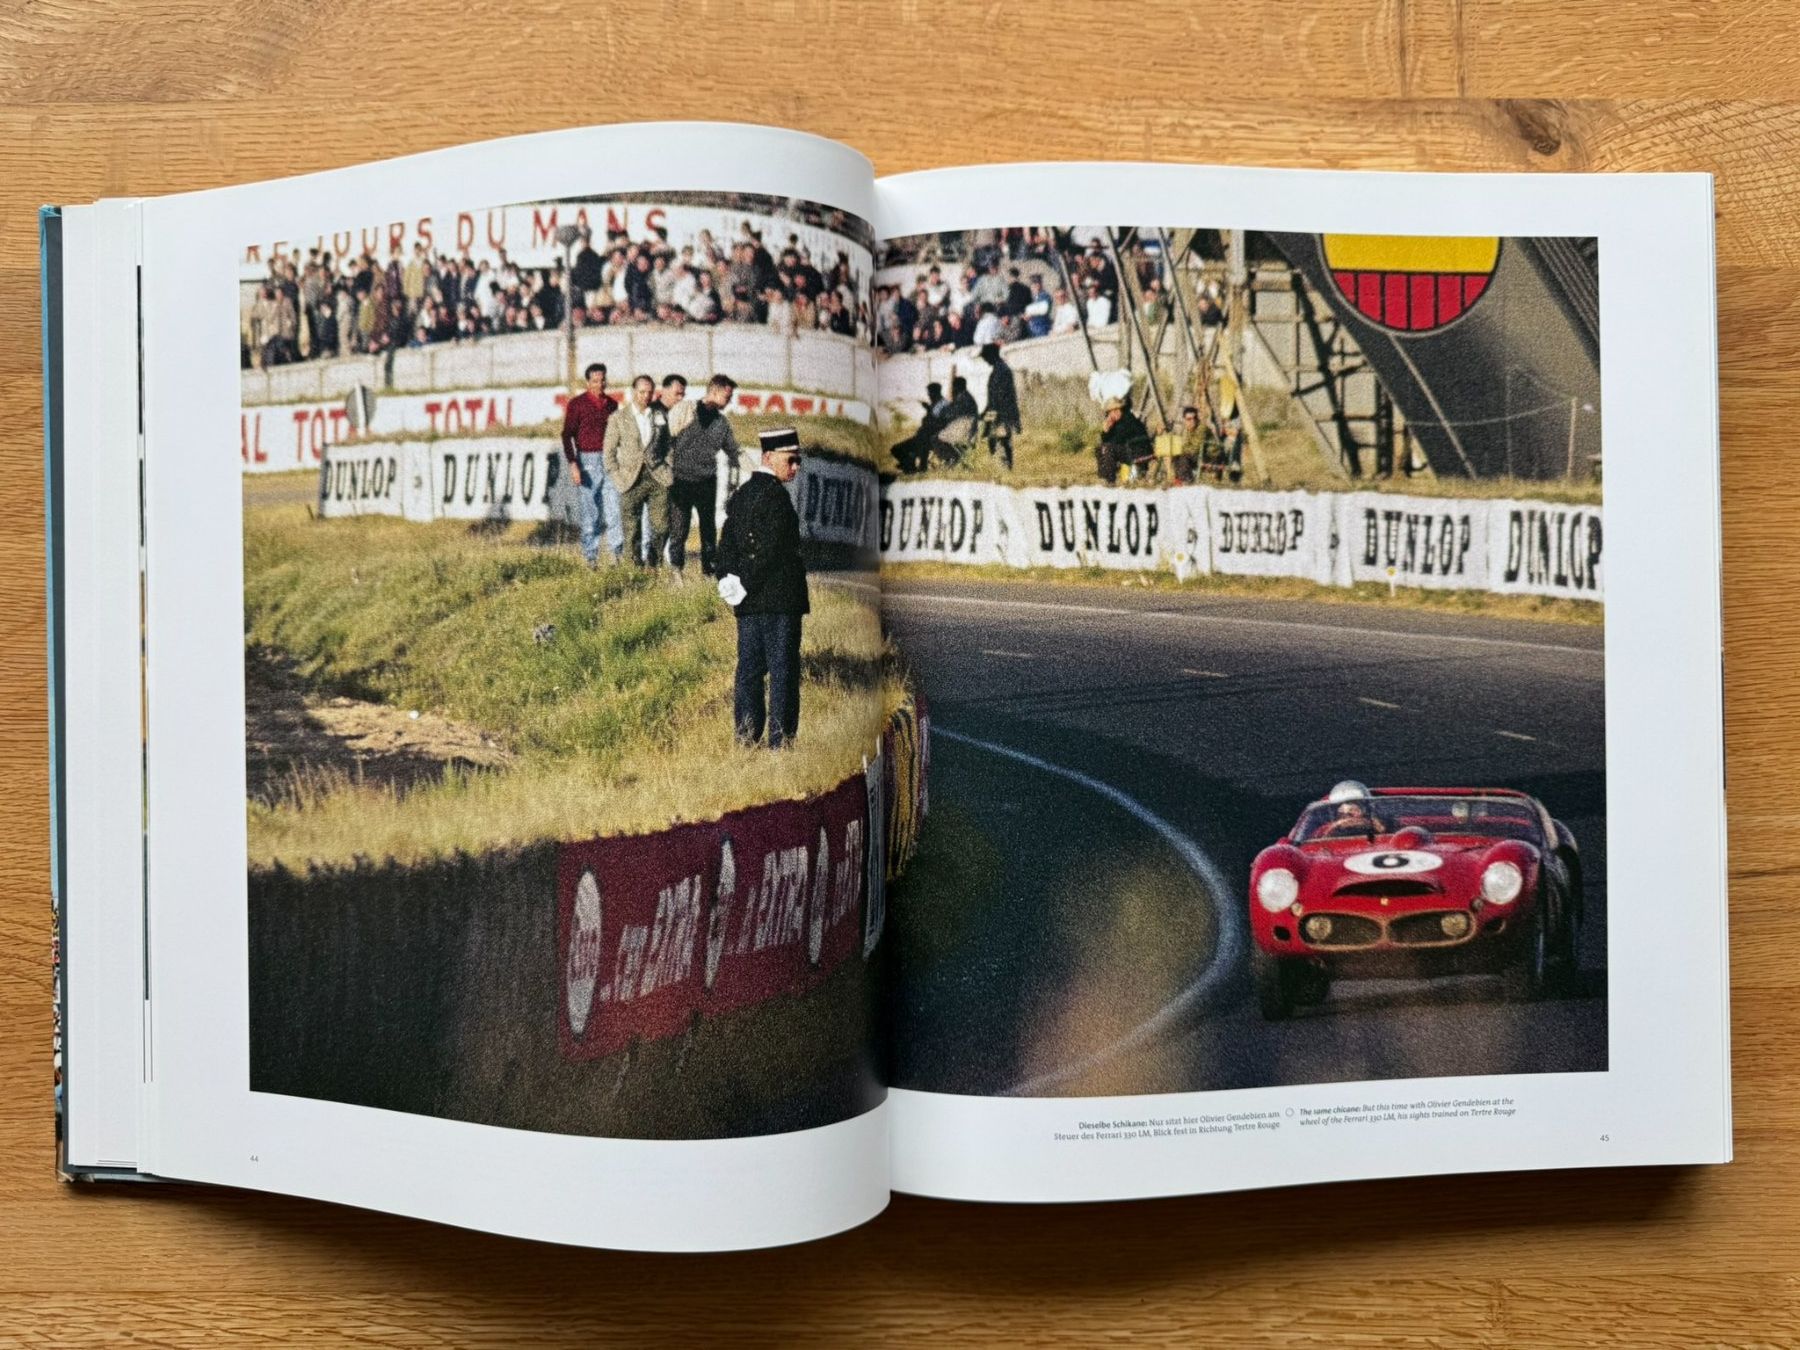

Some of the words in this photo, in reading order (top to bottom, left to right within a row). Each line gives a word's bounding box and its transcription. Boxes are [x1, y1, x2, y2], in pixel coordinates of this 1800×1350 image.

[457, 207, 507, 250] DU
[321, 457, 397, 500] DUNLOP
[443, 453, 560, 504] DUNLOP
[880, 497, 983, 552] DUNLOP
[1035, 500, 1159, 556] DUNLOP
[1363, 507, 1471, 576] DUNLOP
[1504, 510, 1602, 590] DUNLOP
[1078, 1120, 1111, 1130] Dieselbe
[1112, 1119, 1148, 1129] Schikane:
[1149, 1118, 1164, 1127] Nur
[1165, 1117, 1182, 1126] sitzt
[1183, 1115, 1198, 1125] hier
[1199, 1114, 1225, 1123] Olivier
[1226, 1111, 1267, 1121] Gendebien
[1300, 1107, 1312, 1116] The
[1313, 1107, 1332, 1116] same
[1333, 1105, 1361, 1114] chicane:
[1362, 1104, 1375, 1112] But
[1377, 1103, 1390, 1111] this
[1391, 1102, 1409, 1110] time
[1410, 1100, 1426, 1109] with
[1427, 1099, 1452, 1109] Olivier
[1452, 1098, 1492, 1108] Gendebien
[1492, 1098, 1501, 1106] at
[1502, 1097, 1515, 1106] the
[1300, 1117, 1320, 1126] wheel
[1321, 1117, 1330, 1126] of
[1330, 1116, 1343, 1124] the
[1344, 1115, 1368, 1123] Ferrari
[1369, 1115, 1382, 1123] 330
[1383, 1113, 1396, 1121] LM,
[1397, 1112, 1408, 1120] his
[1409, 1110, 1430, 1121] sights
[1431, 1109, 1458, 1118] trained
[1459, 1109, 1469, 1117] on
[1470, 1108, 1492, 1116] Tertre
[1493, 1107, 1516, 1117] Rouge
[1054, 1132, 1079, 1141] Steuer
[1080, 1131, 1095, 1140] des
[1096, 1131, 1122, 1140] Ferrari
[1123, 1132, 1137, 1140] 330
[1138, 1129, 1152, 1138] LM,
[1153, 1128, 1171, 1137] Blick
[1173, 1127, 1188, 1136] fest
[1189, 1126, 1197, 1135] in
[1199, 1124, 1233, 1134] Richtung
[1234, 1122, 1256, 1131] Tertre
[1257, 1120, 1280, 1130] Rouge
[1600, 1134, 1609, 1142] 45
[250, 1154, 259, 1163] 44
